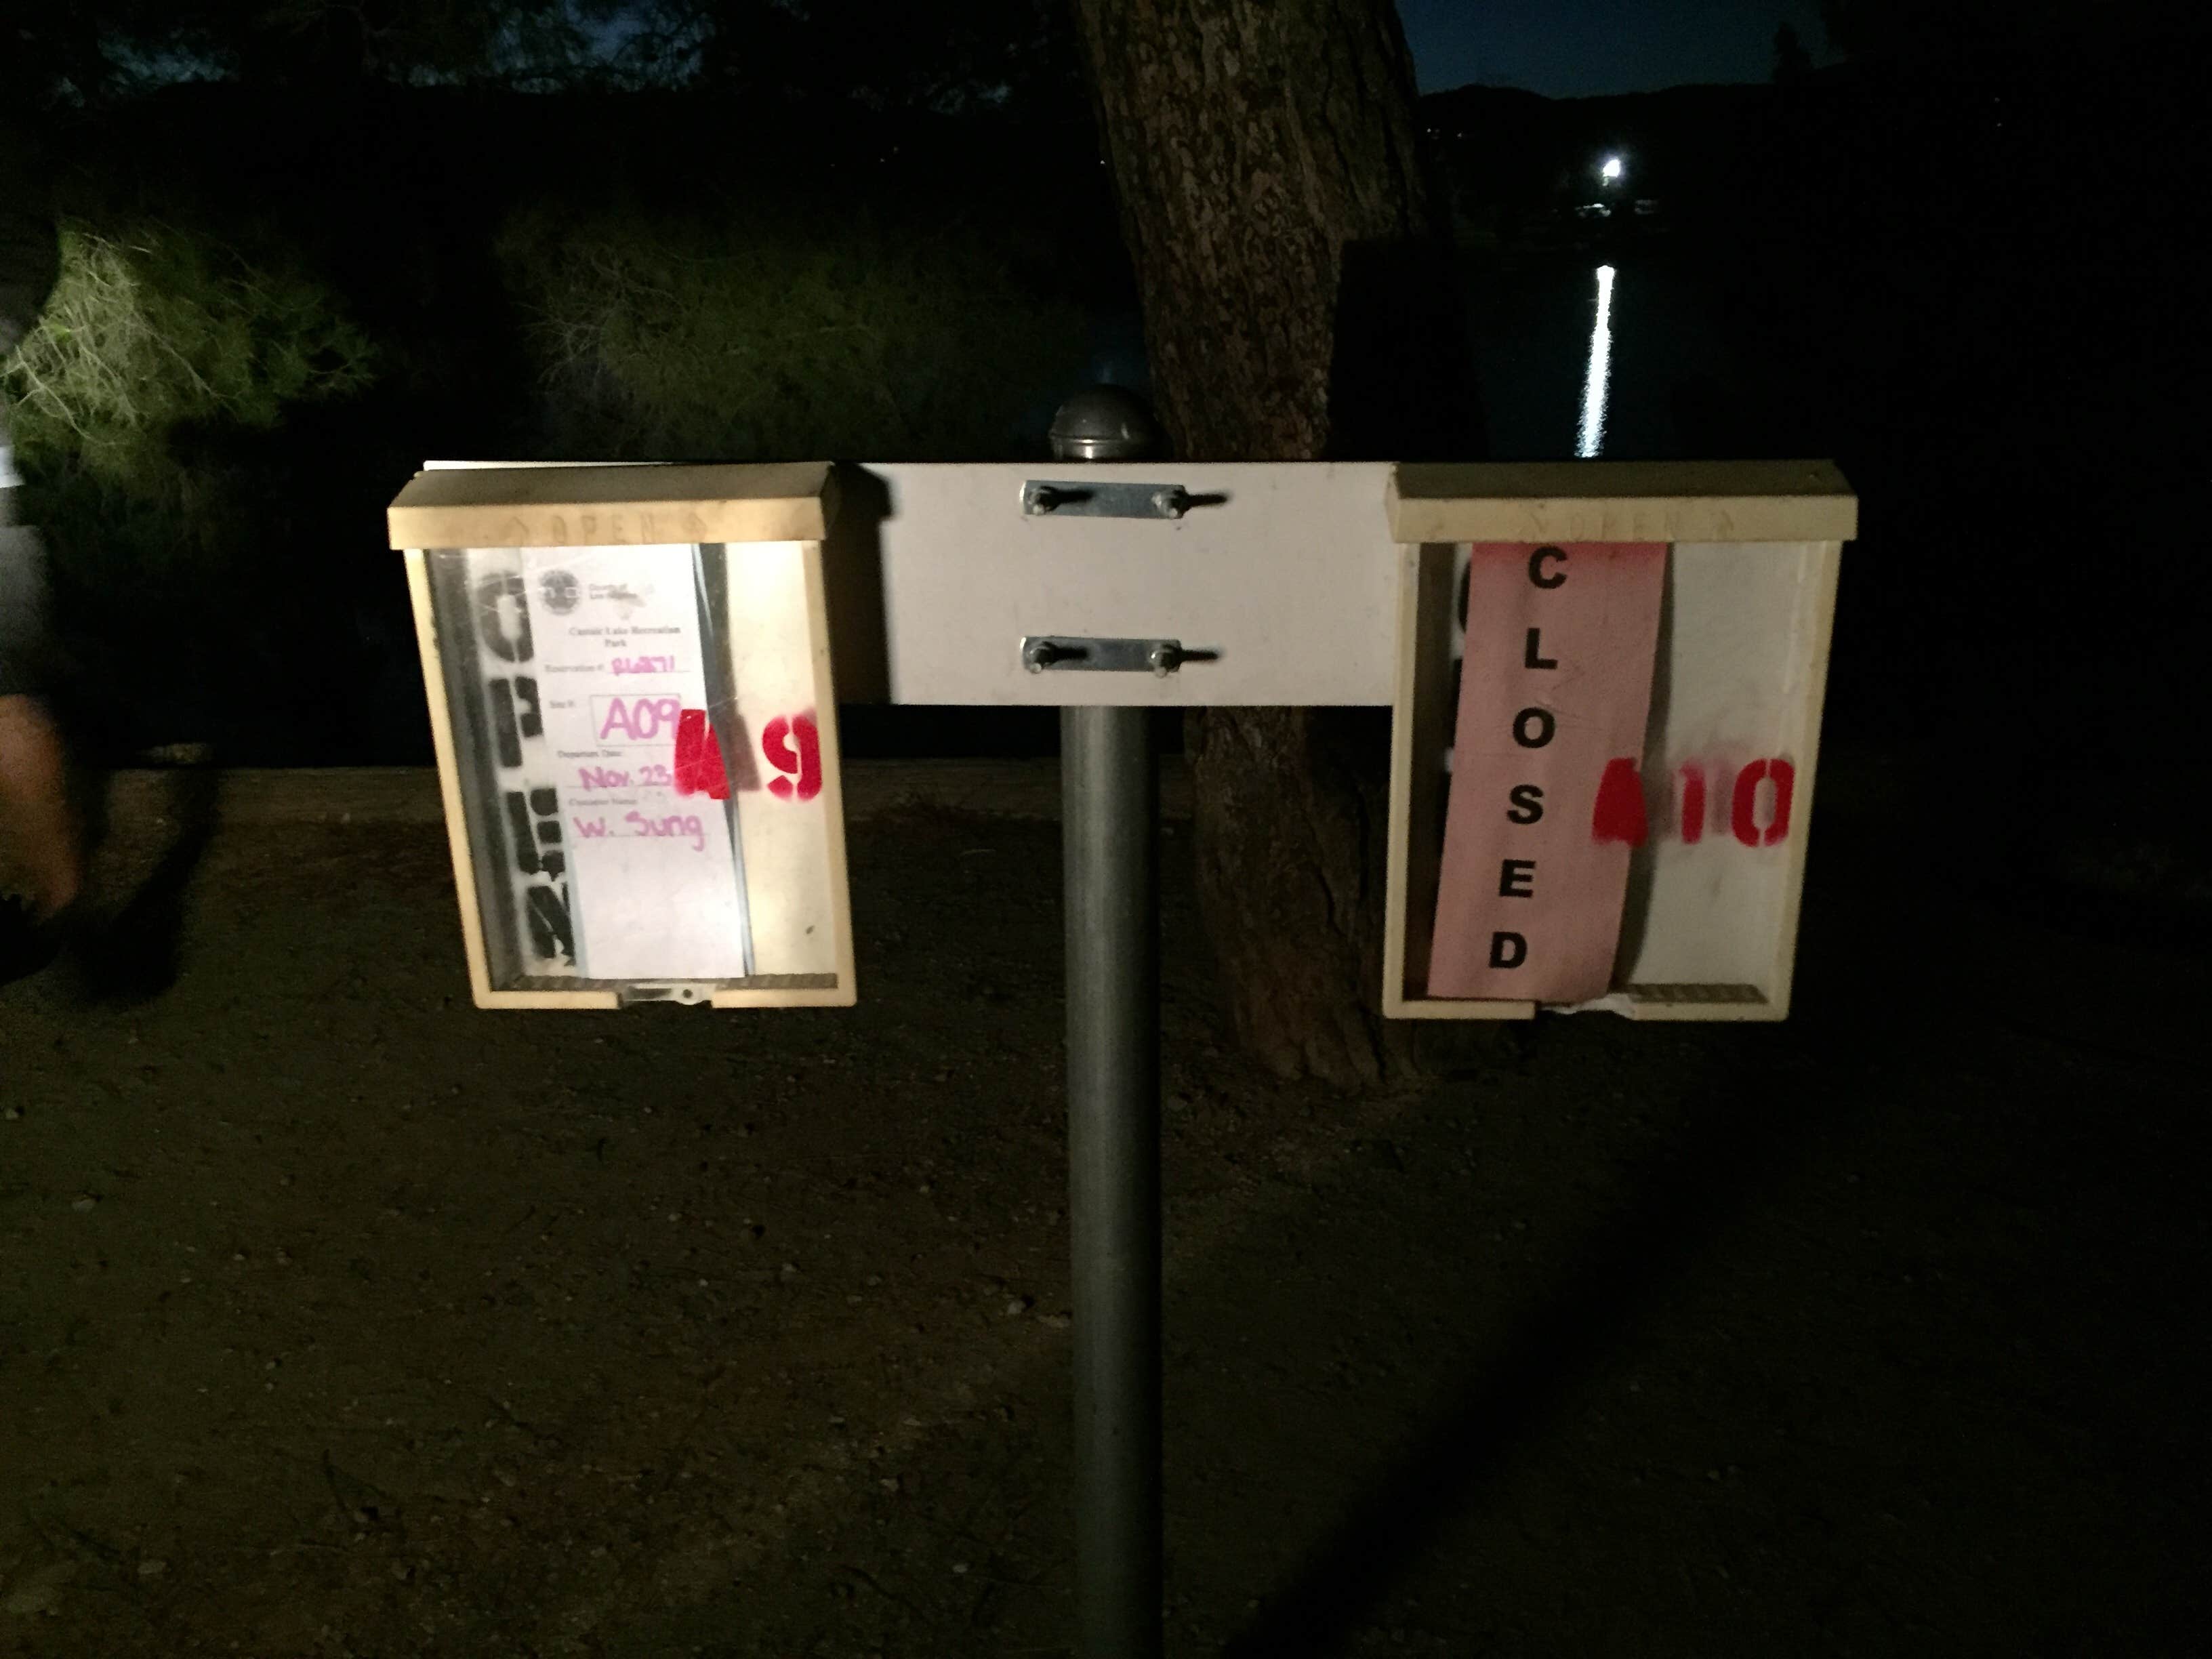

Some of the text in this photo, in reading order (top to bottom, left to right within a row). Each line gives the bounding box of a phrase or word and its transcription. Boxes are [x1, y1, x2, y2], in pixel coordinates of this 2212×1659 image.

[599, 697, 681, 740] A09
[1488, 546, 1569, 970] CLOSED
[625, 811, 705, 852] Sung
